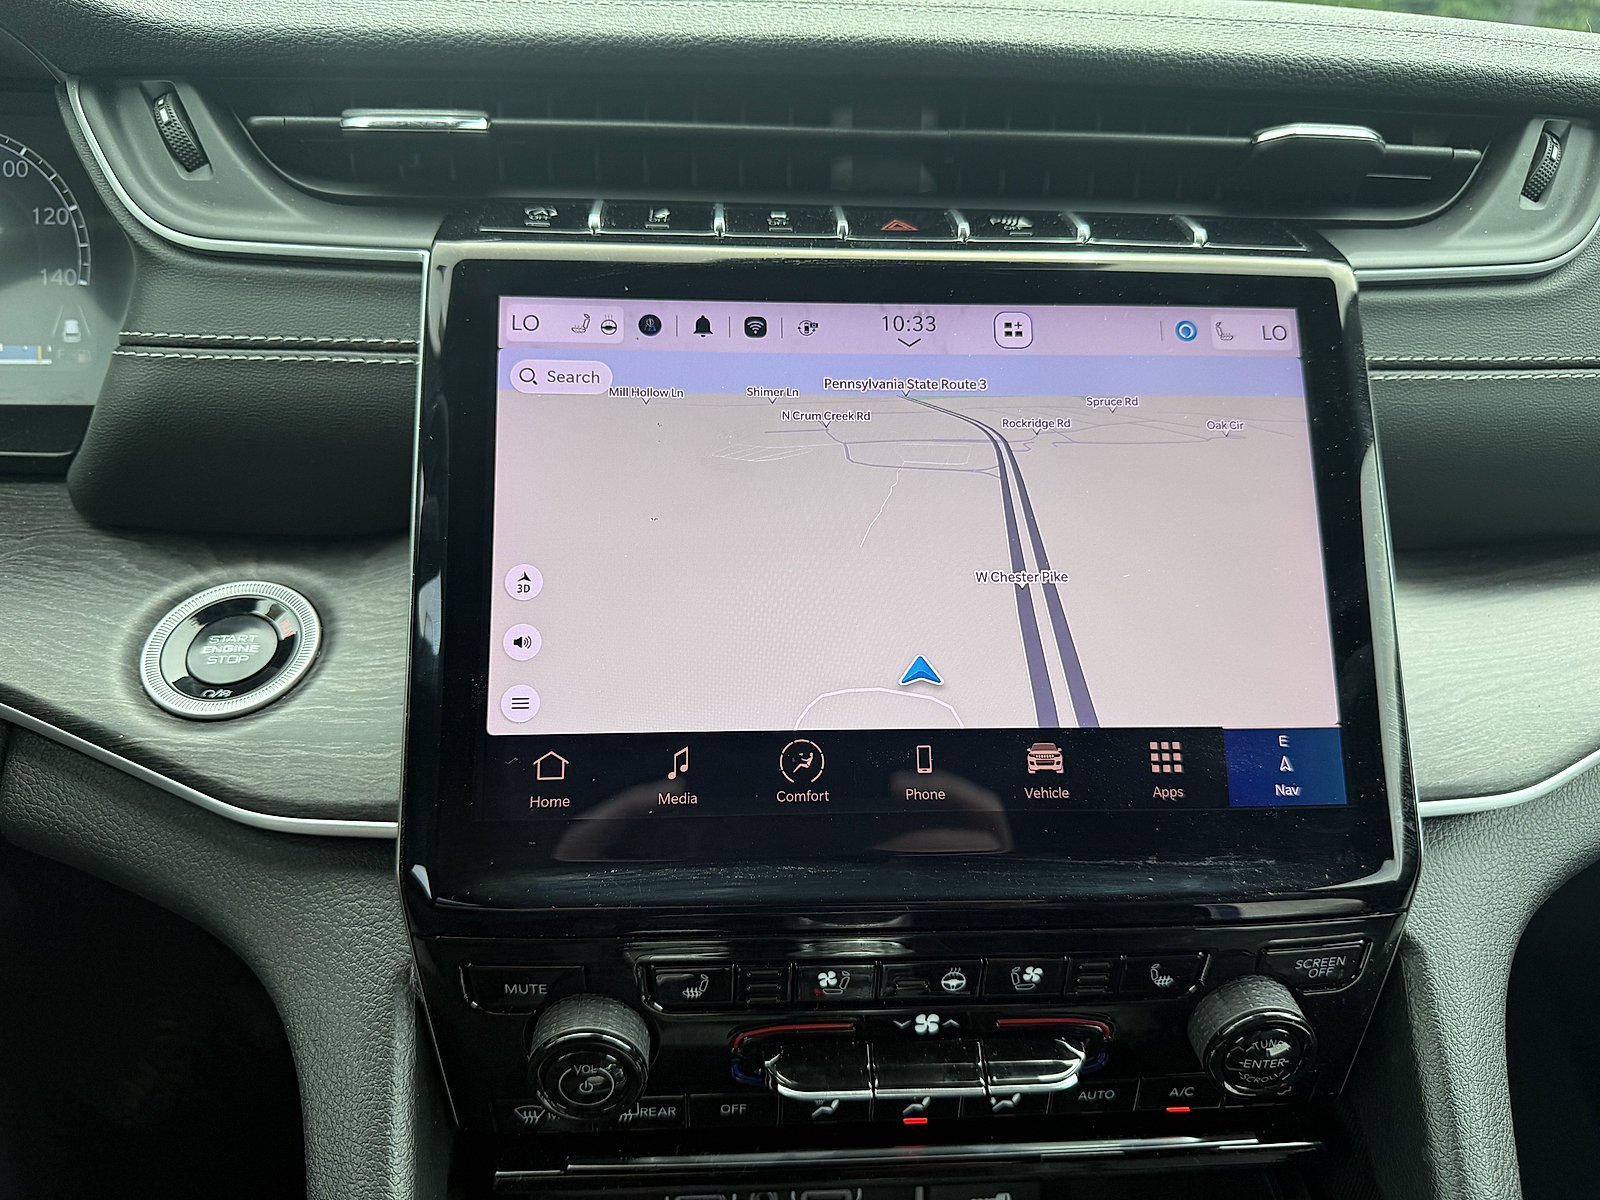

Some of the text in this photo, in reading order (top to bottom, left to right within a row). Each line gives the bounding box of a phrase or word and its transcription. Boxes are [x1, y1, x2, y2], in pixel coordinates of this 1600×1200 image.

[2, 159, 29, 178] 00
[32, 207, 70, 226] 120
[40, 268, 78, 287] 140
[512, 314, 540, 332] LO
[882, 315, 937, 333] 10:33
[1262, 325, 1287, 342] LO
[547, 369, 601, 385] Search
[824, 378, 988, 392] Pennsylvania State Route 3
[609, 386, 684, 398] Mill Hollow Ln
[746, 386, 799, 398] Shimer Ln
[1086, 396, 1138, 409] Spruce Rd
[782, 411, 871, 422] N Crum Creek Rd
[1002, 418, 1071, 431] Rockridge Rd
[1206, 420, 1244, 431] Oak Cir
[975, 571, 1068, 583] W Chester Pike
[516, 584, 531, 594] 3D
[209, 634, 258, 644] START
[202, 644, 259, 654] ENGINE
[206, 655, 249, 665] STOP
[1278, 735, 1290, 748] E
[776, 790, 830, 803] Comfort
[905, 788, 946, 801] Phone
[1024, 787, 1070, 799] Vehicle
[1153, 786, 1184, 800] Apps
[1275, 784, 1301, 797] Nav
[530, 796, 571, 809] Home
[658, 793, 698, 806] Media
[1295, 956, 1346, 970] SCREEN
[1308, 966, 1335, 979] OFF
[504, 983, 548, 996] MUTE
[573, 1064, 597, 1076] VOL
[1078, 1089, 1115, 1101] AUTO
[1169, 1086, 1195, 1098] A/C
[640, 1106, 677, 1118] REAR
[720, 1103, 747, 1115] OFF
